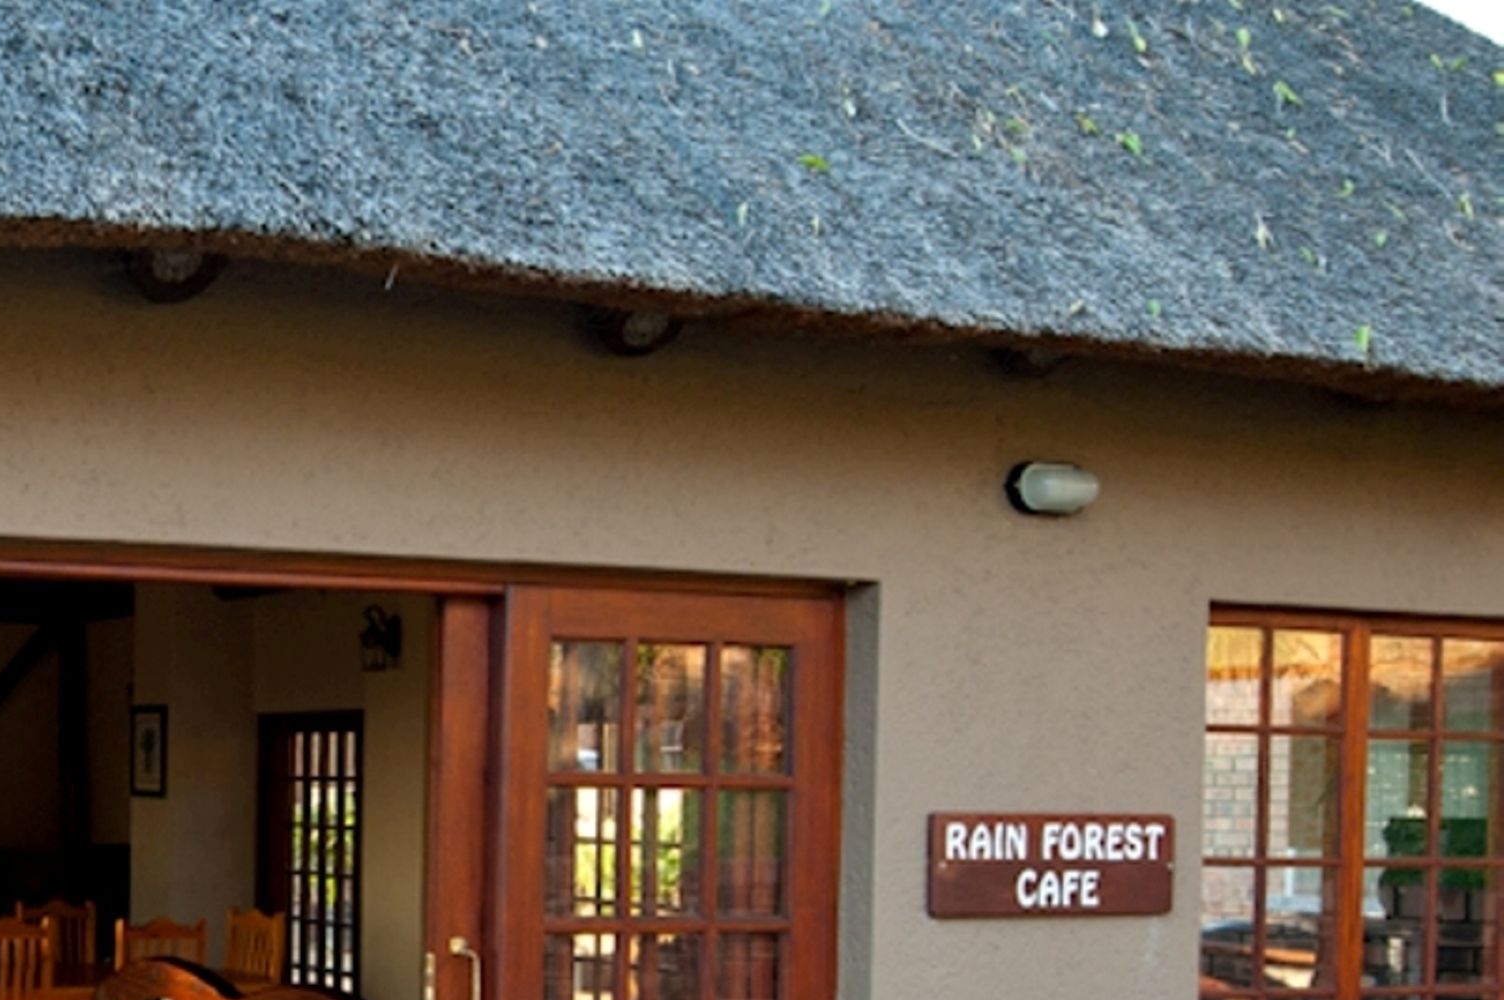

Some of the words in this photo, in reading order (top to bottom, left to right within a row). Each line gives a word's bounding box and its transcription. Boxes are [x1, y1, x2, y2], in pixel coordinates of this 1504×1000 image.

[945, 822, 1027, 860] RAIN
[1042, 822, 1165, 861] FOREST
[1016, 869, 1099, 908] CAFE
